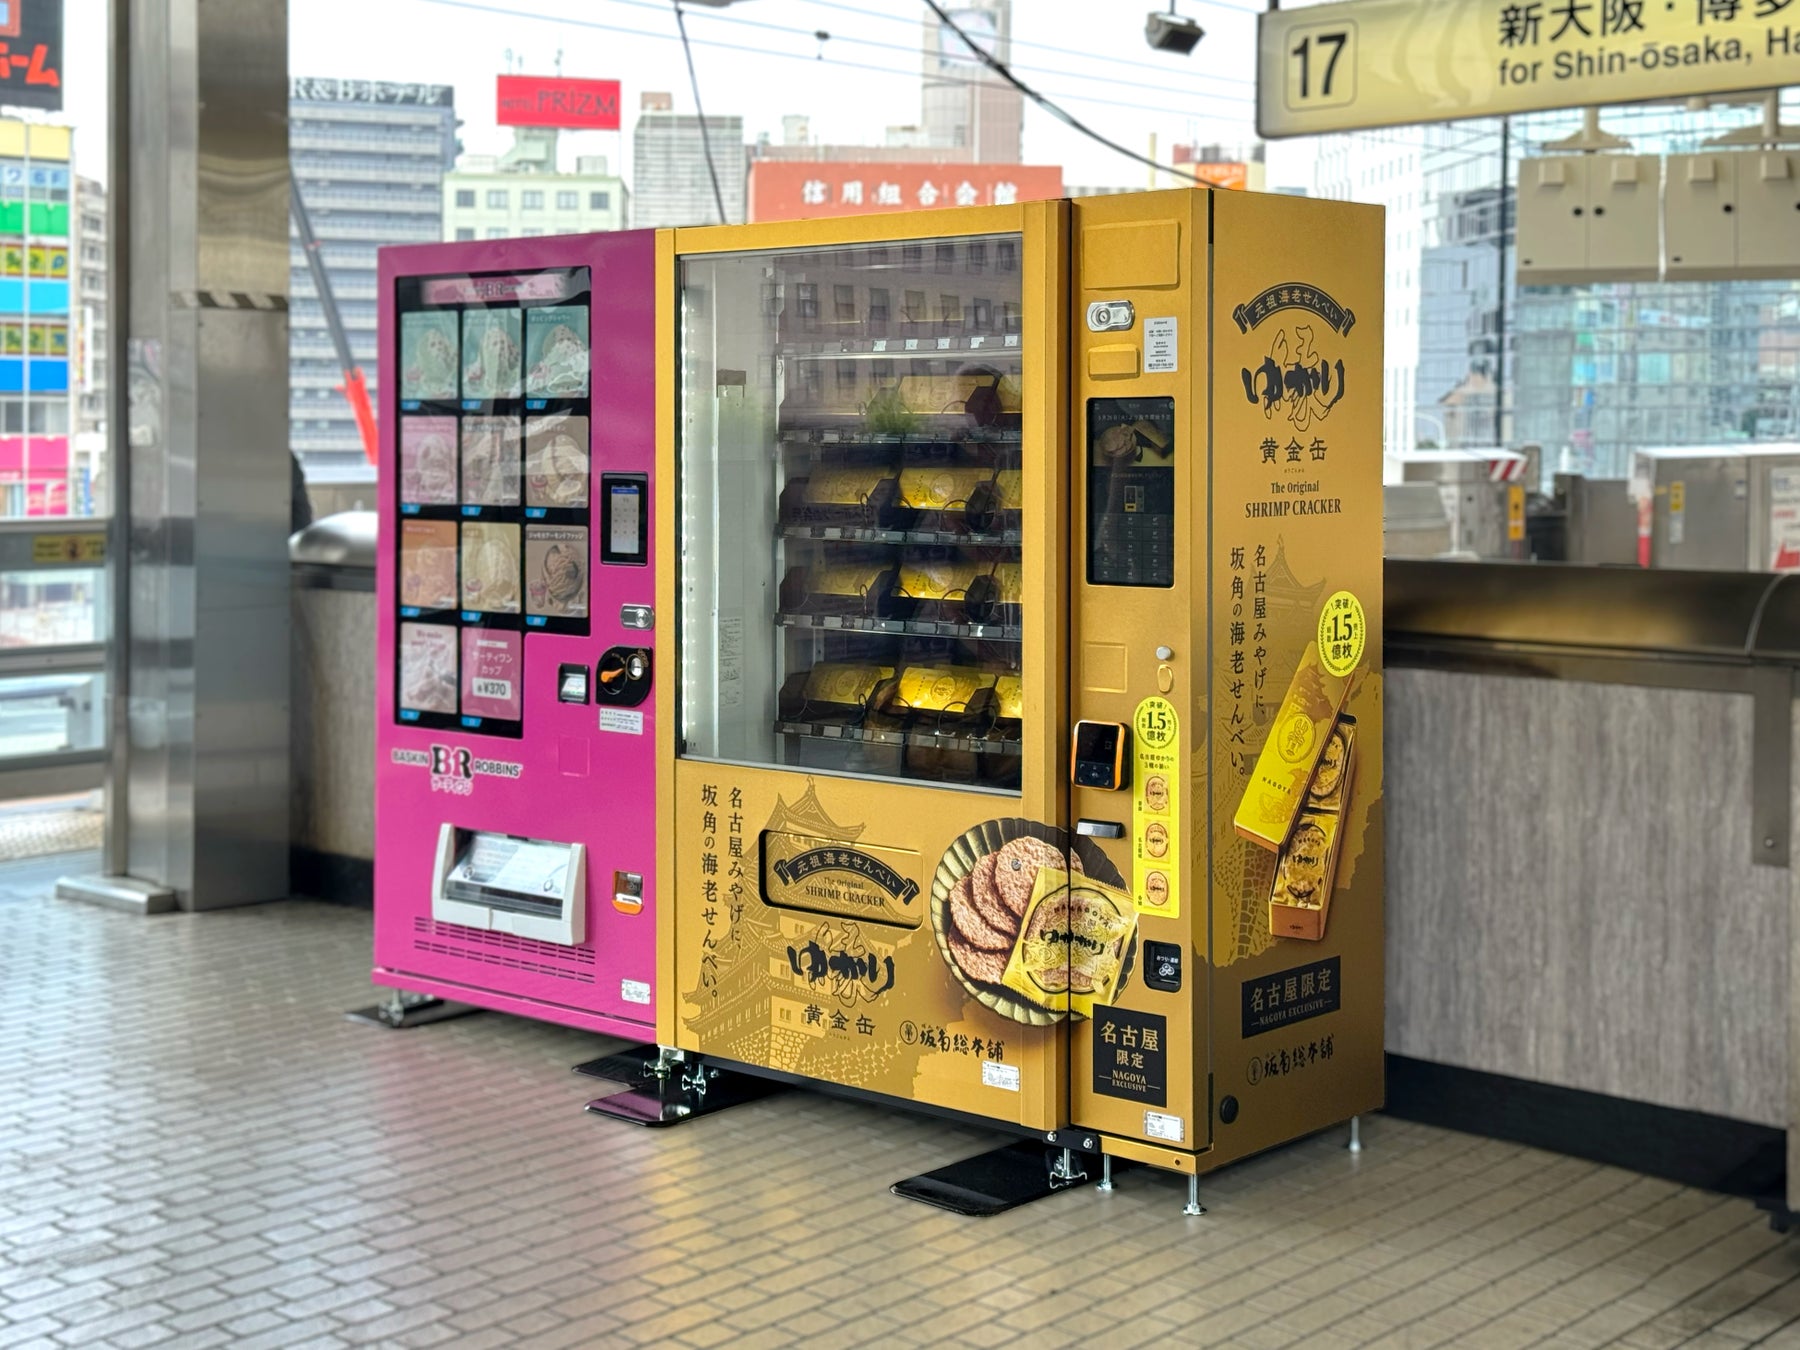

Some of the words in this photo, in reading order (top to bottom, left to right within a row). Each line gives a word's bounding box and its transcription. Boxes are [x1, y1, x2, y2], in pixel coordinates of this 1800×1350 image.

[1291, 32, 1348, 99] 17
[1499, 58, 1543, 86] for
[1553, 35, 1753, 81] Shin-ōsaka,
[1254, 288, 1339, 321] 元祖海老せんべい
[1260, 436, 1328, 465] 黄金缶
[1271, 481, 1286, 494] The
[1287, 480, 1320, 496] Original
[1245, 501, 1290, 519] SHRIMP
[1292, 498, 1342, 516] CRACKER
[1252, 544, 1268, 716] 名古屋みやげに、
[1229, 546, 1246, 776] 坂角の海老せんべい。
[1146, 711, 1167, 730] 1.5
[393, 749, 428, 765] BASKIN
[474, 760, 520, 778] ROBBINS
[728, 786, 744, 951] 名古屋みやげに、
[796, 851, 896, 889] 元祖海老せんべい
[824, 876, 836, 885] The
[837, 878, 864, 890] Original
[701, 783, 719, 998] 坂角の海老せんべい。
[805, 885, 841, 899] SHRIMP
[843, 890, 886, 907] CRACKER
[1250, 967, 1332, 1013] 名古屋限定
[804, 1003, 876, 1037] 黄金缶
[1101, 1021, 1160, 1052] 名古屋
[1116, 1049, 1145, 1069] 限定
[1111, 1080, 1147, 1093] EXCLUSIVE
[1112, 1070, 1147, 1085] NAGOYA
